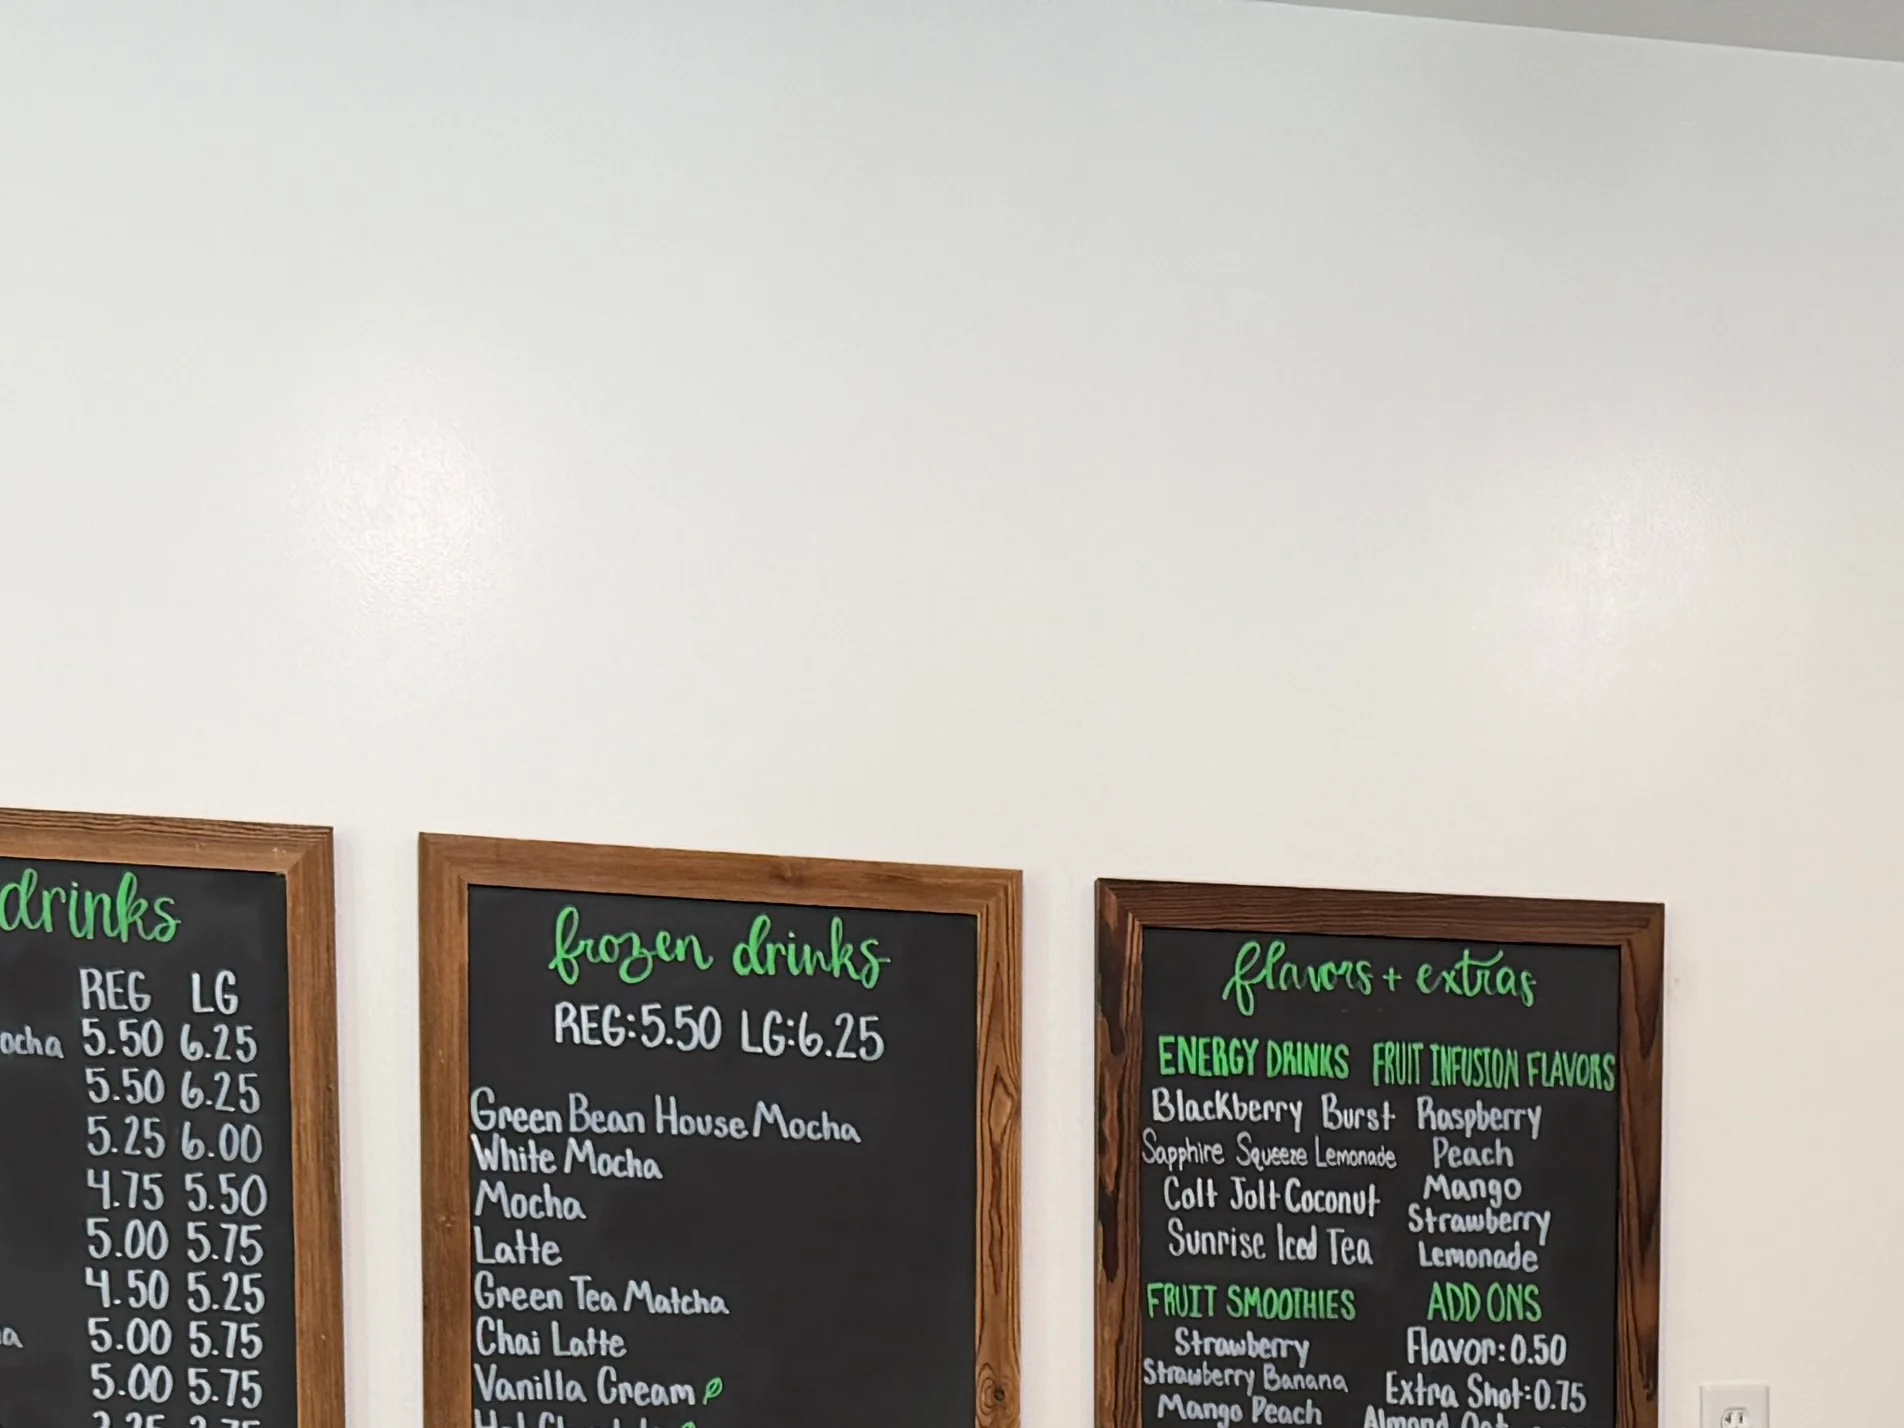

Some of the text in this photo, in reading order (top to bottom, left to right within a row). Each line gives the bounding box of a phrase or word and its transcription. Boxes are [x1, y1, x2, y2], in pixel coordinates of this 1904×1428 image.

[548, 906, 891, 989] frozen drinks
[79, 967, 239, 1015] REG LG
[1221, 940, 1374, 1016] flavors
[1416, 948, 1537, 1008] extras
[1158, 1035, 1350, 1079] ENERGY DRINKS
[1372, 1041, 1616, 1092] FRUIT INFUSION FLAVORS
[85, 1067, 165, 1105] 5.50
[180, 1070, 260, 1114] 6.25
[1151, 1086, 1396, 1133] Blackberry Burst
[1416, 1095, 1542, 1140] Raspberry
[1432, 1136, 1514, 1169] Peach
[86, 1217, 169, 1261] 5.00
[187, 1221, 264, 1266] 5.75
[473, 1363, 696, 1407] Vanilla Cream
[1143, 1357, 1349, 1397] Strawberry Banana
